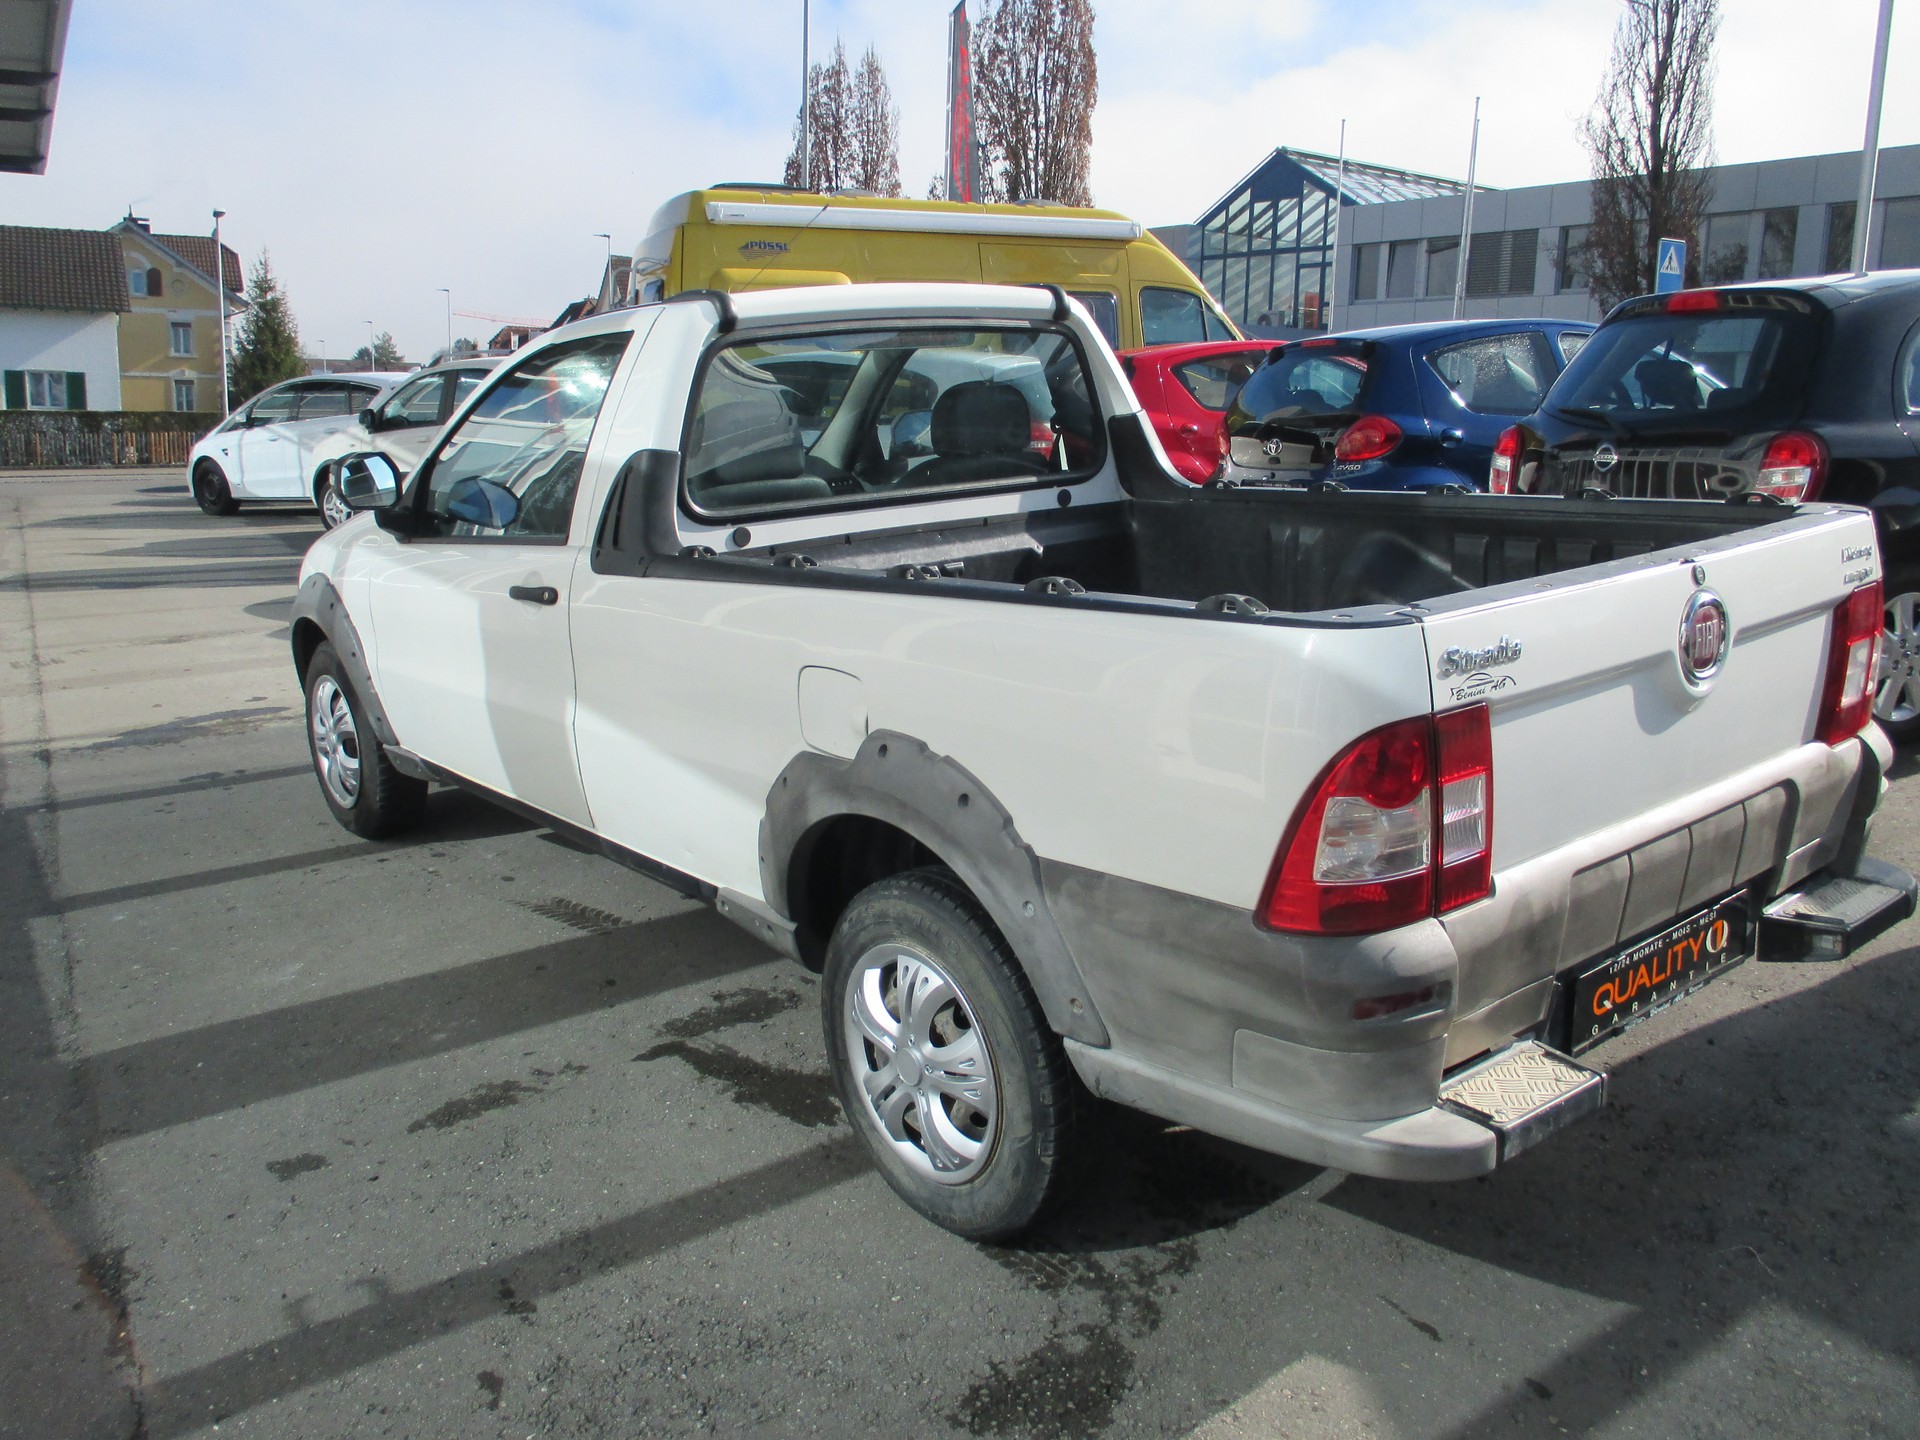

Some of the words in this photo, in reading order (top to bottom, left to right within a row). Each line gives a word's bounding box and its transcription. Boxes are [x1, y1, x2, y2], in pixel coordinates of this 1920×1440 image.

[1439, 635, 1522, 678] Strada
[1695, 619, 1718, 659] FIAT
[1456, 687, 1486, 701] Benini
[1490, 677, 1507, 693] AG
[1609, 956, 1630, 975] 12/24
[1633, 939, 1663, 962] MONATE
[1672, 924, 1691, 941] MOIS
[1699, 910, 1717, 926] MESI
[1591, 953, 1727, 1035] GARANTIE
